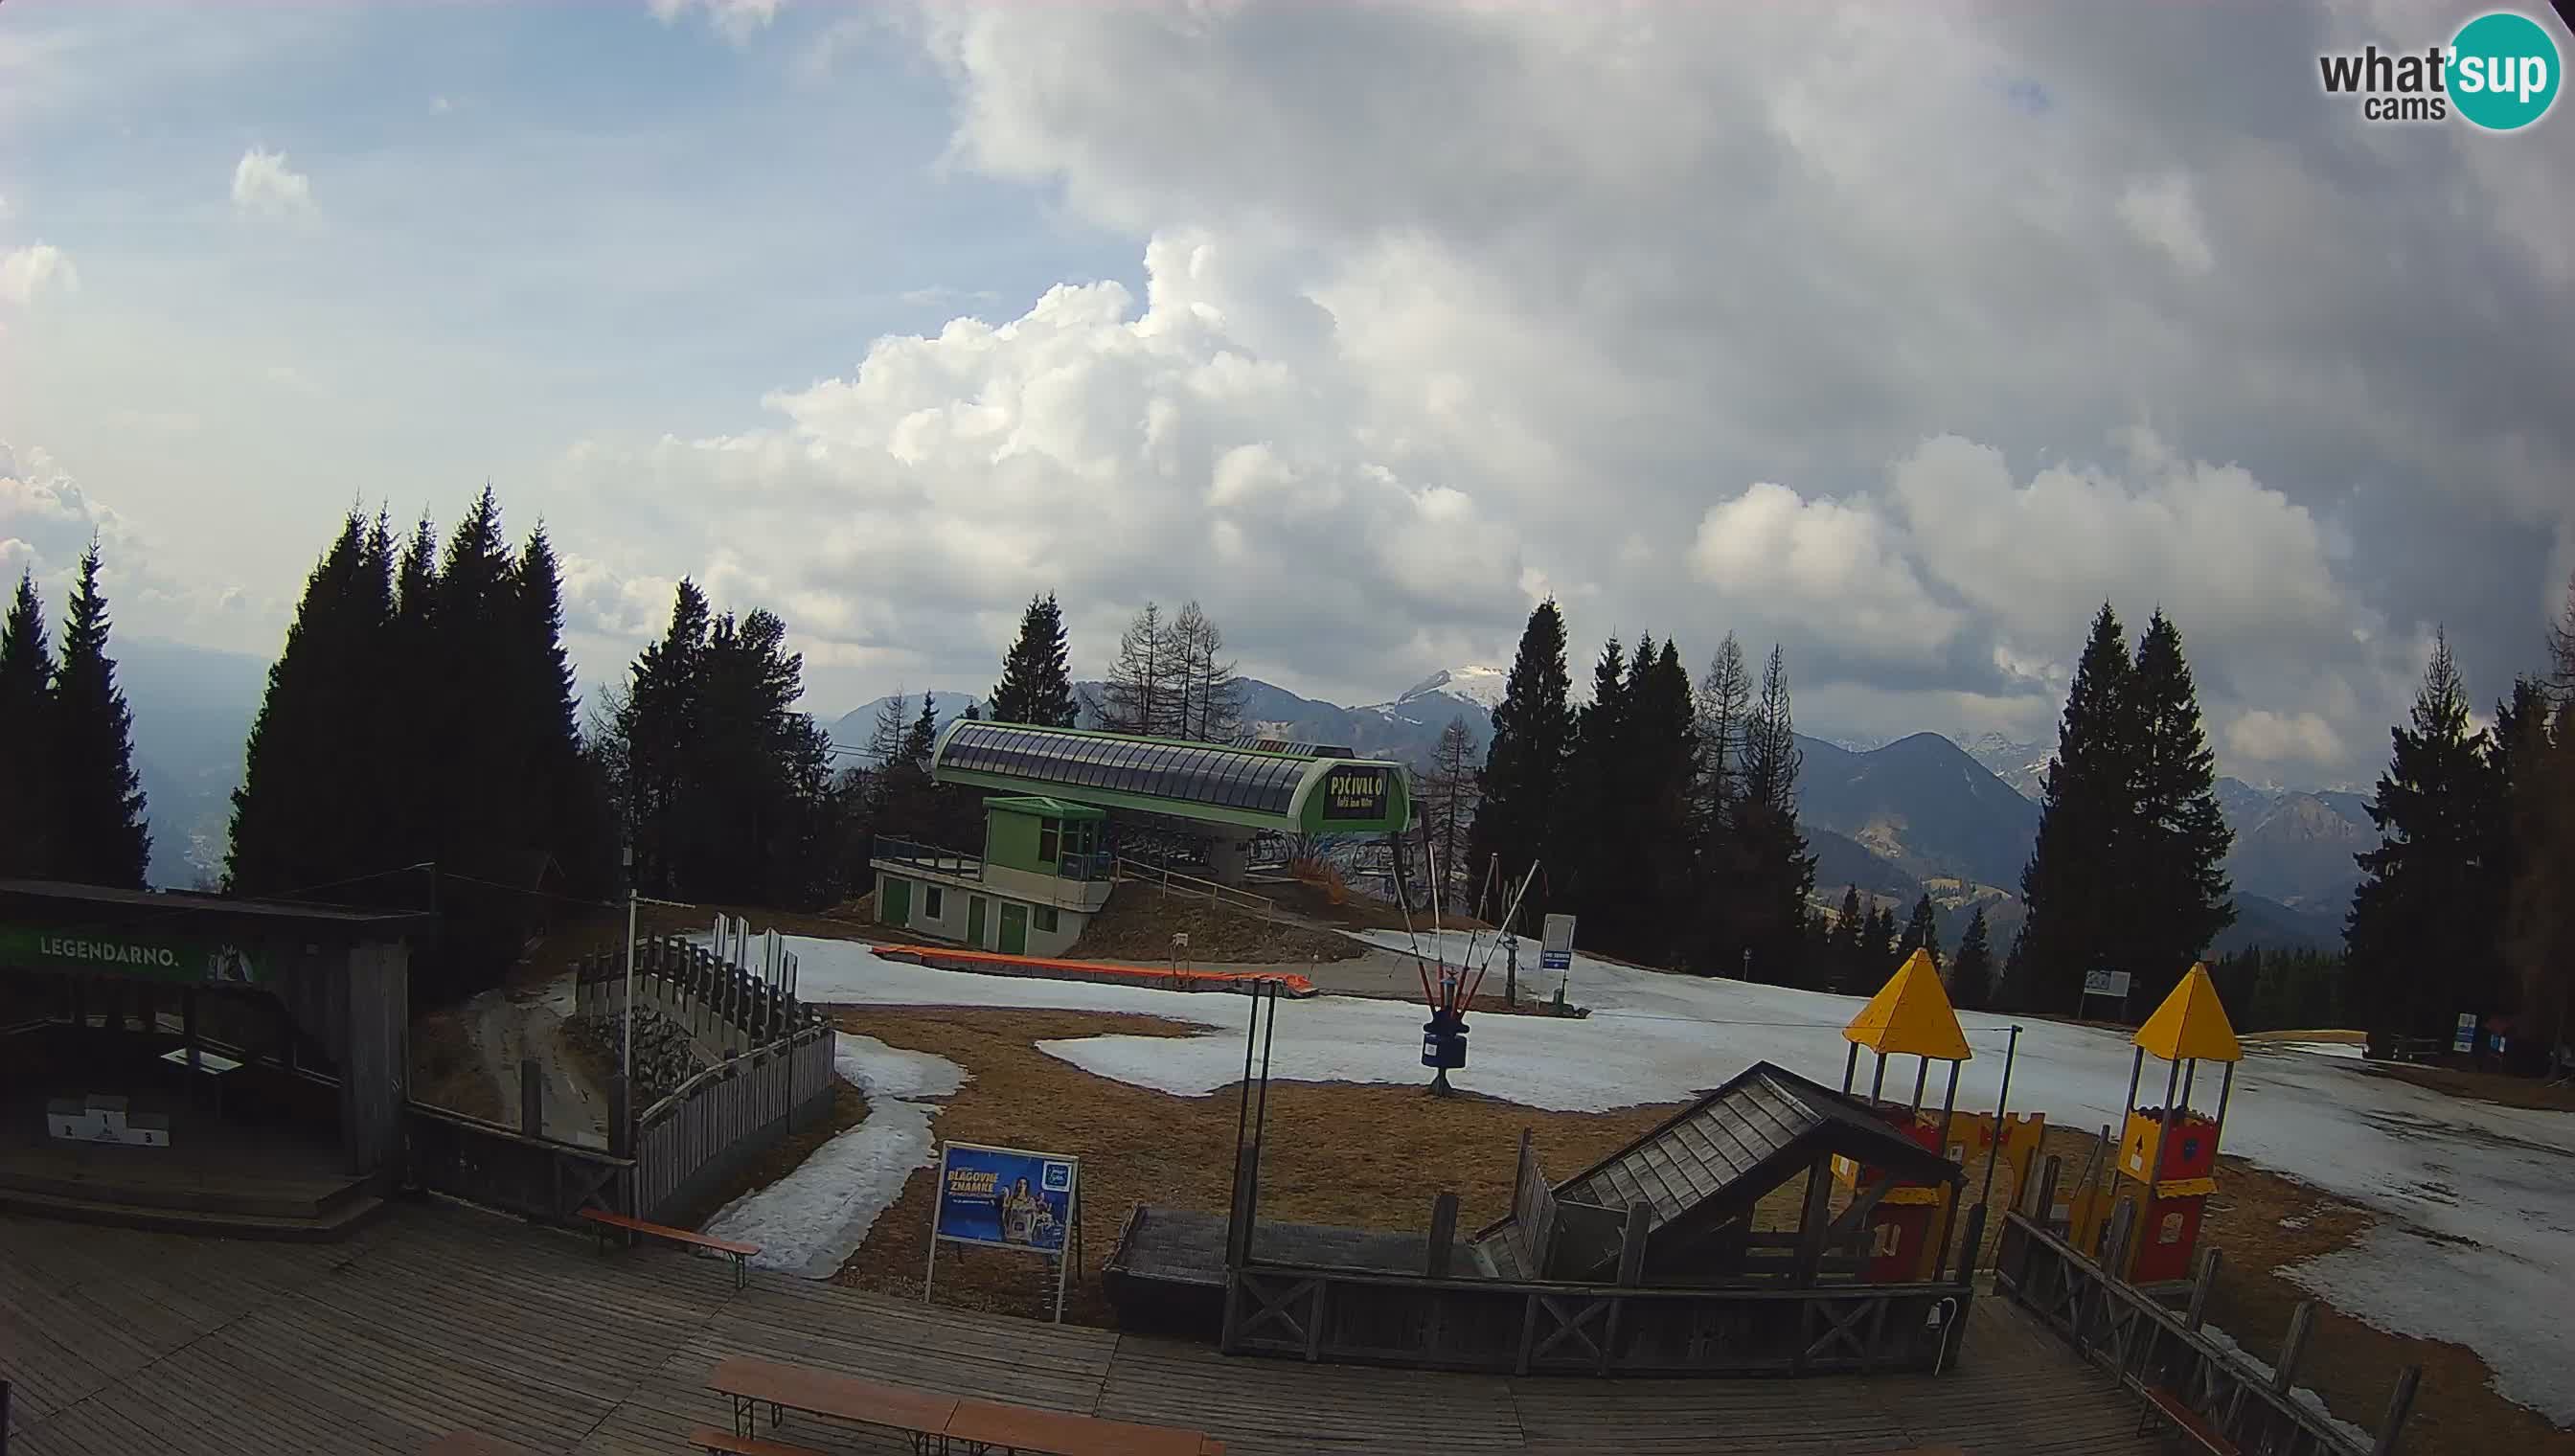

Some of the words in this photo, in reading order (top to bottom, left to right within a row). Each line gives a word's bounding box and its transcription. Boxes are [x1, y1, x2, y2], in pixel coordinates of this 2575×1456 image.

[40, 937, 179, 967] LEGENDARNO.
[947, 1171, 999, 1183] BLAGOVNE
[950, 1181, 994, 1193] ZNAMKE
